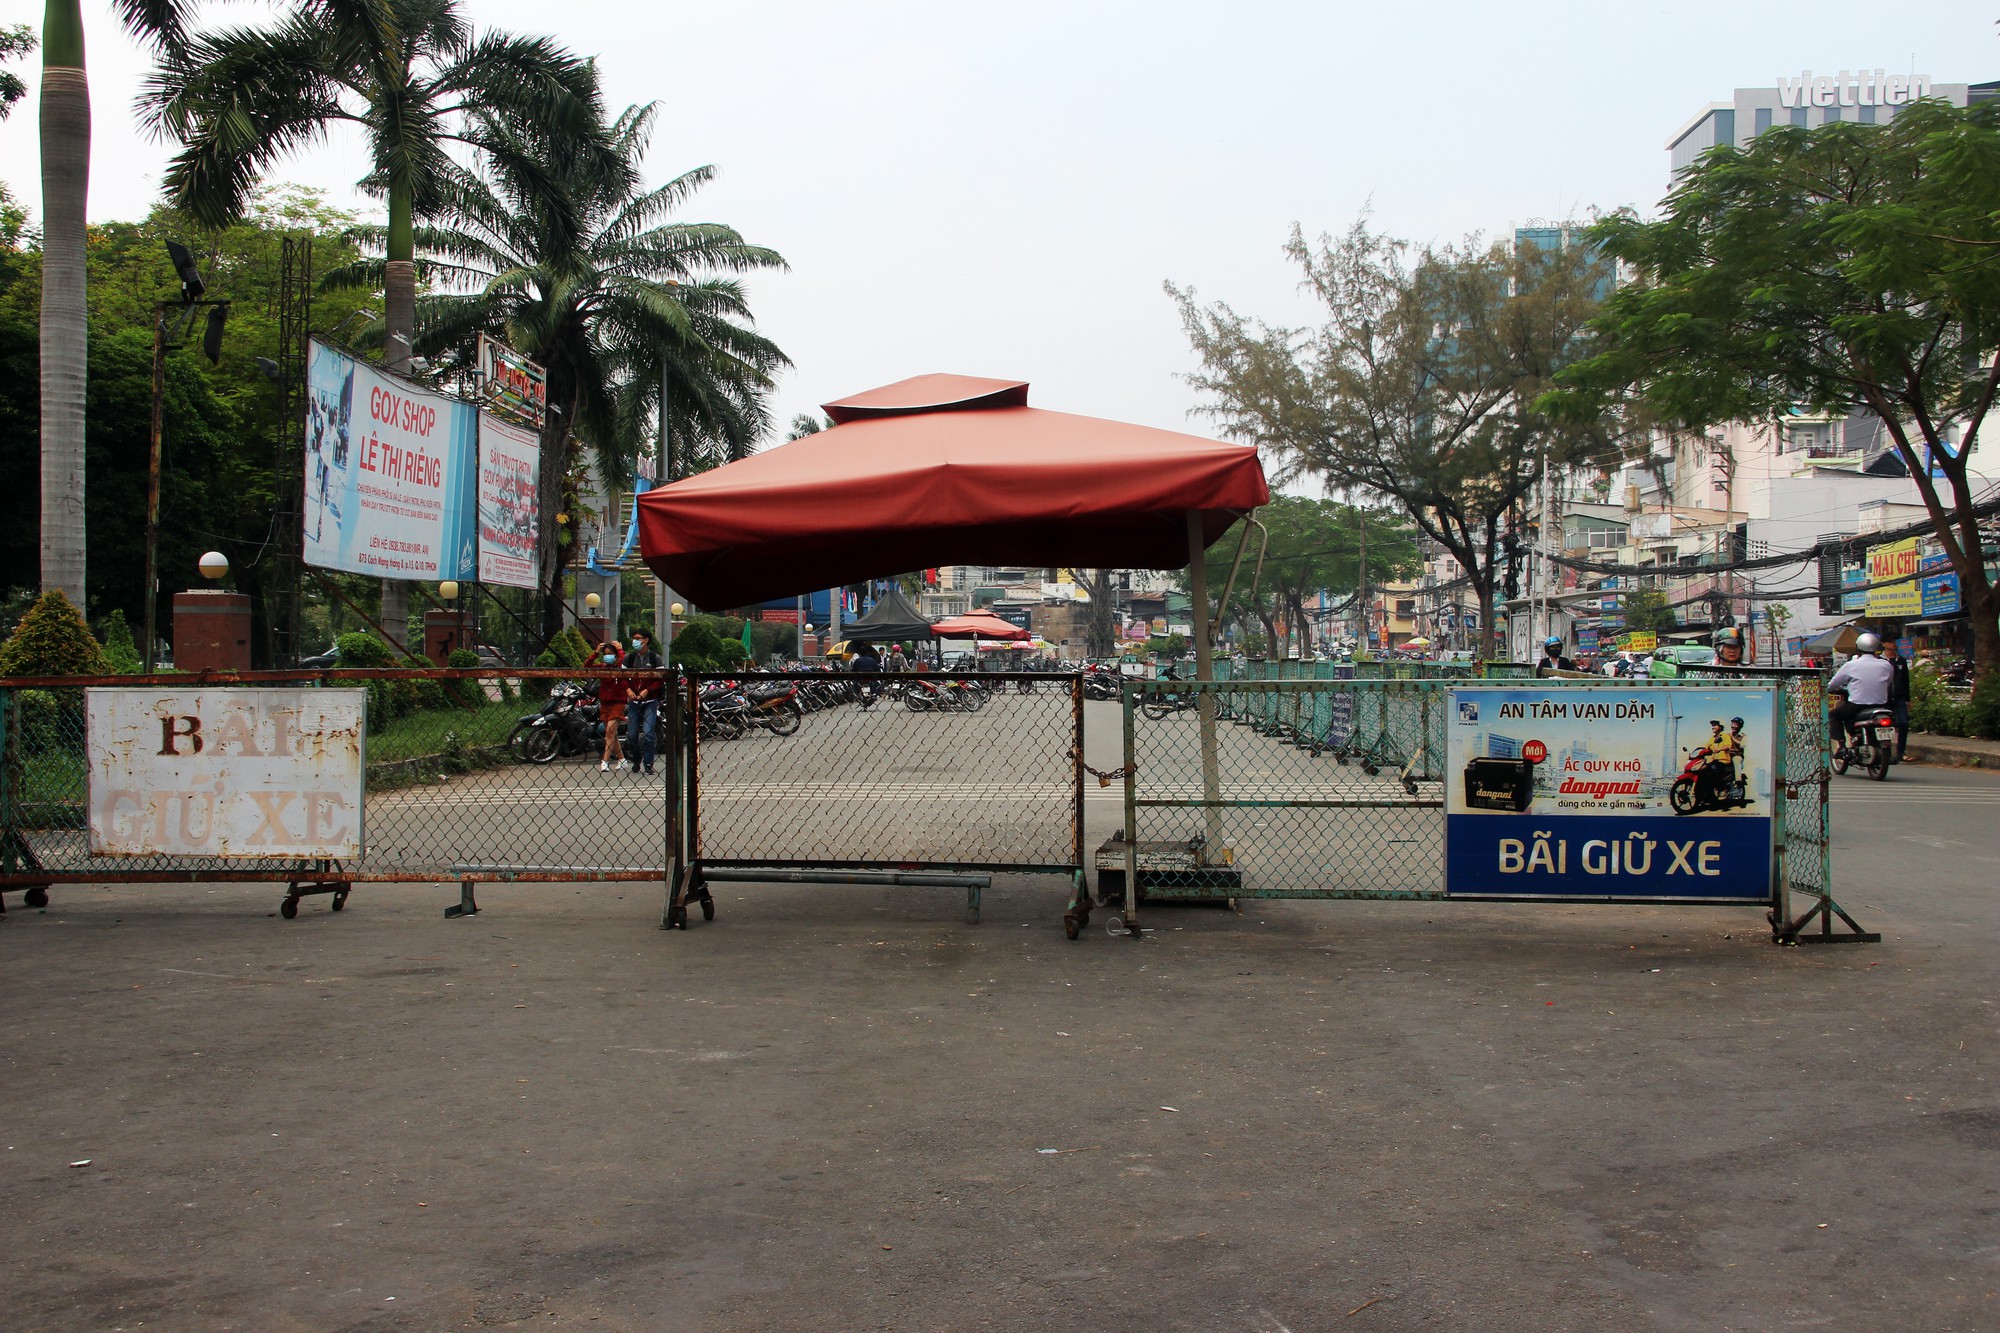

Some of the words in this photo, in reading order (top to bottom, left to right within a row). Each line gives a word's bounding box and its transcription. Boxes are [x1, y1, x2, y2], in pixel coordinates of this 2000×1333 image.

[1776, 68, 1931, 108] viettien
[371, 386, 401, 427] GOX
[403, 400, 435, 437] SHOP
[360, 430, 378, 472] LÊ
[382, 443, 402, 486] THỊ
[405, 447, 440, 488] RIÊNG
[359, 553, 367, 563] 875
[1499, 703, 1524, 719] AN
[1529, 699, 1567, 719] TÂM
[1573, 703, 1609, 722] VẠN
[1616, 699, 1655, 722] DẶM
[1526, 745, 1543, 756] Mới
[1564, 757, 1580, 772] ẮC
[1584, 761, 1610, 774] QUY
[1614, 758, 1641, 772] KHÔ
[245, 791, 348, 846] XE
[1558, 800, 1578, 809] dùng
[1581, 800, 1595, 808] cho
[1609, 799, 1624, 809] gắn
[1627, 801, 1642, 810] máy
[1499, 831, 1567, 874] BÃI
[1582, 832, 1657, 876] GIỮ
[1665, 840, 1721, 876] XE
